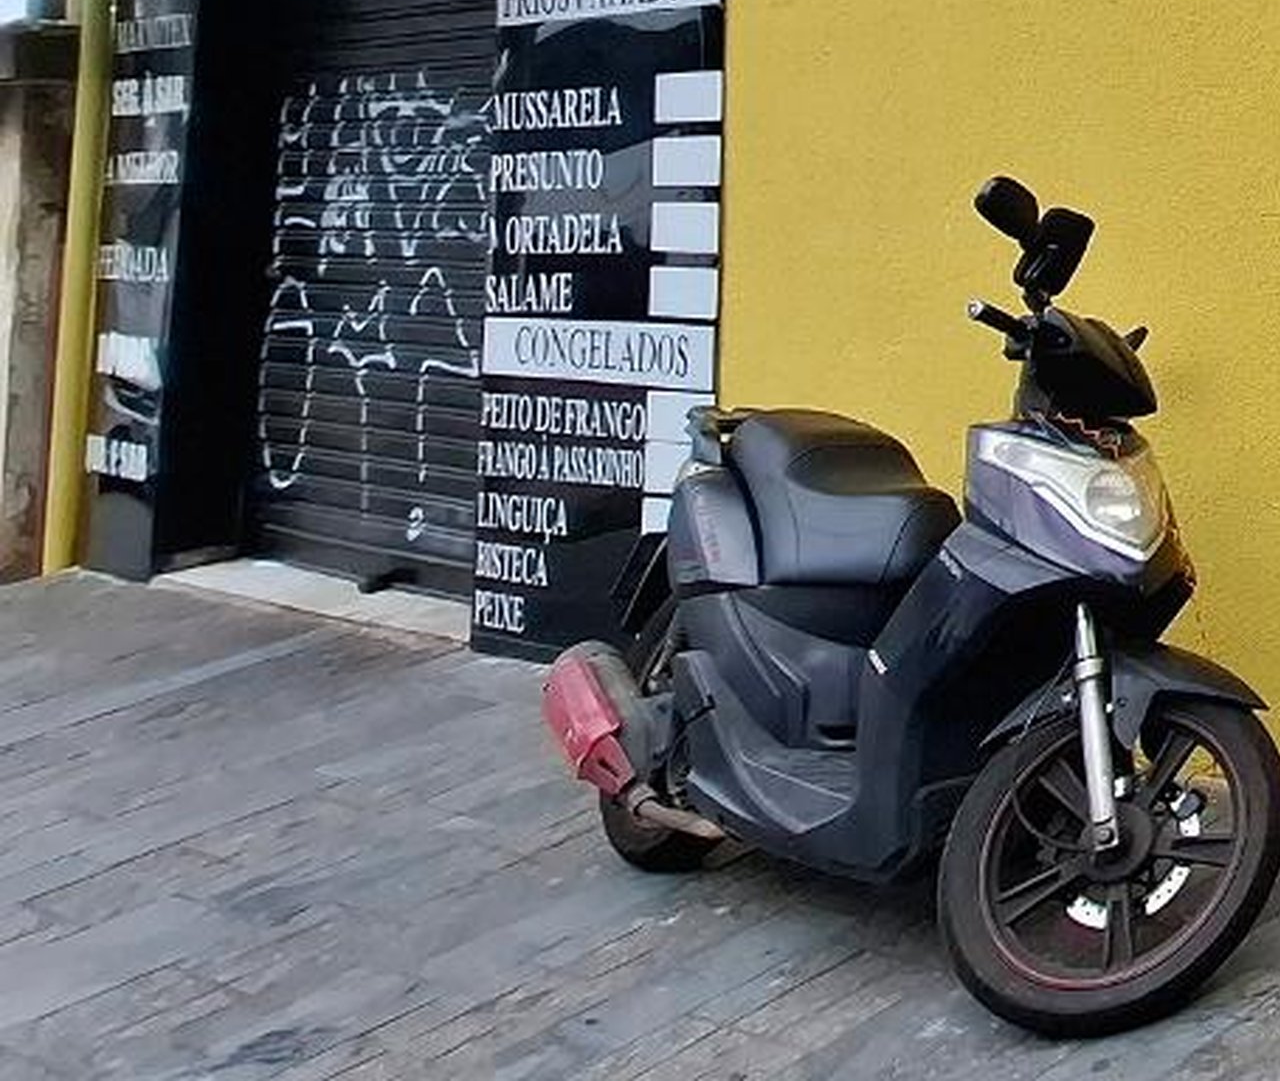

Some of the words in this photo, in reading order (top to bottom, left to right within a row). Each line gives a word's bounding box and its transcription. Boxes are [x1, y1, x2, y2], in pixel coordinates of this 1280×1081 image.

[492, 85, 623, 131] MUSSARELA
[489, 149, 603, 193] PRESUNTO
[485, 272, 573, 314] SALAME
[514, 325, 689, 378] CONGELADOS
[480, 392, 533, 431] PEITO
[534, 395, 562, 435] DE
[563, 398, 646, 442] FRANGO
[476, 441, 537, 480] FRANGO
[552, 444, 644, 489] PASSARINHO
[477, 492, 568, 545] LINGUIÇA
[475, 540, 548, 587] BISTECA
[474, 588, 526, 634] PEIXE
